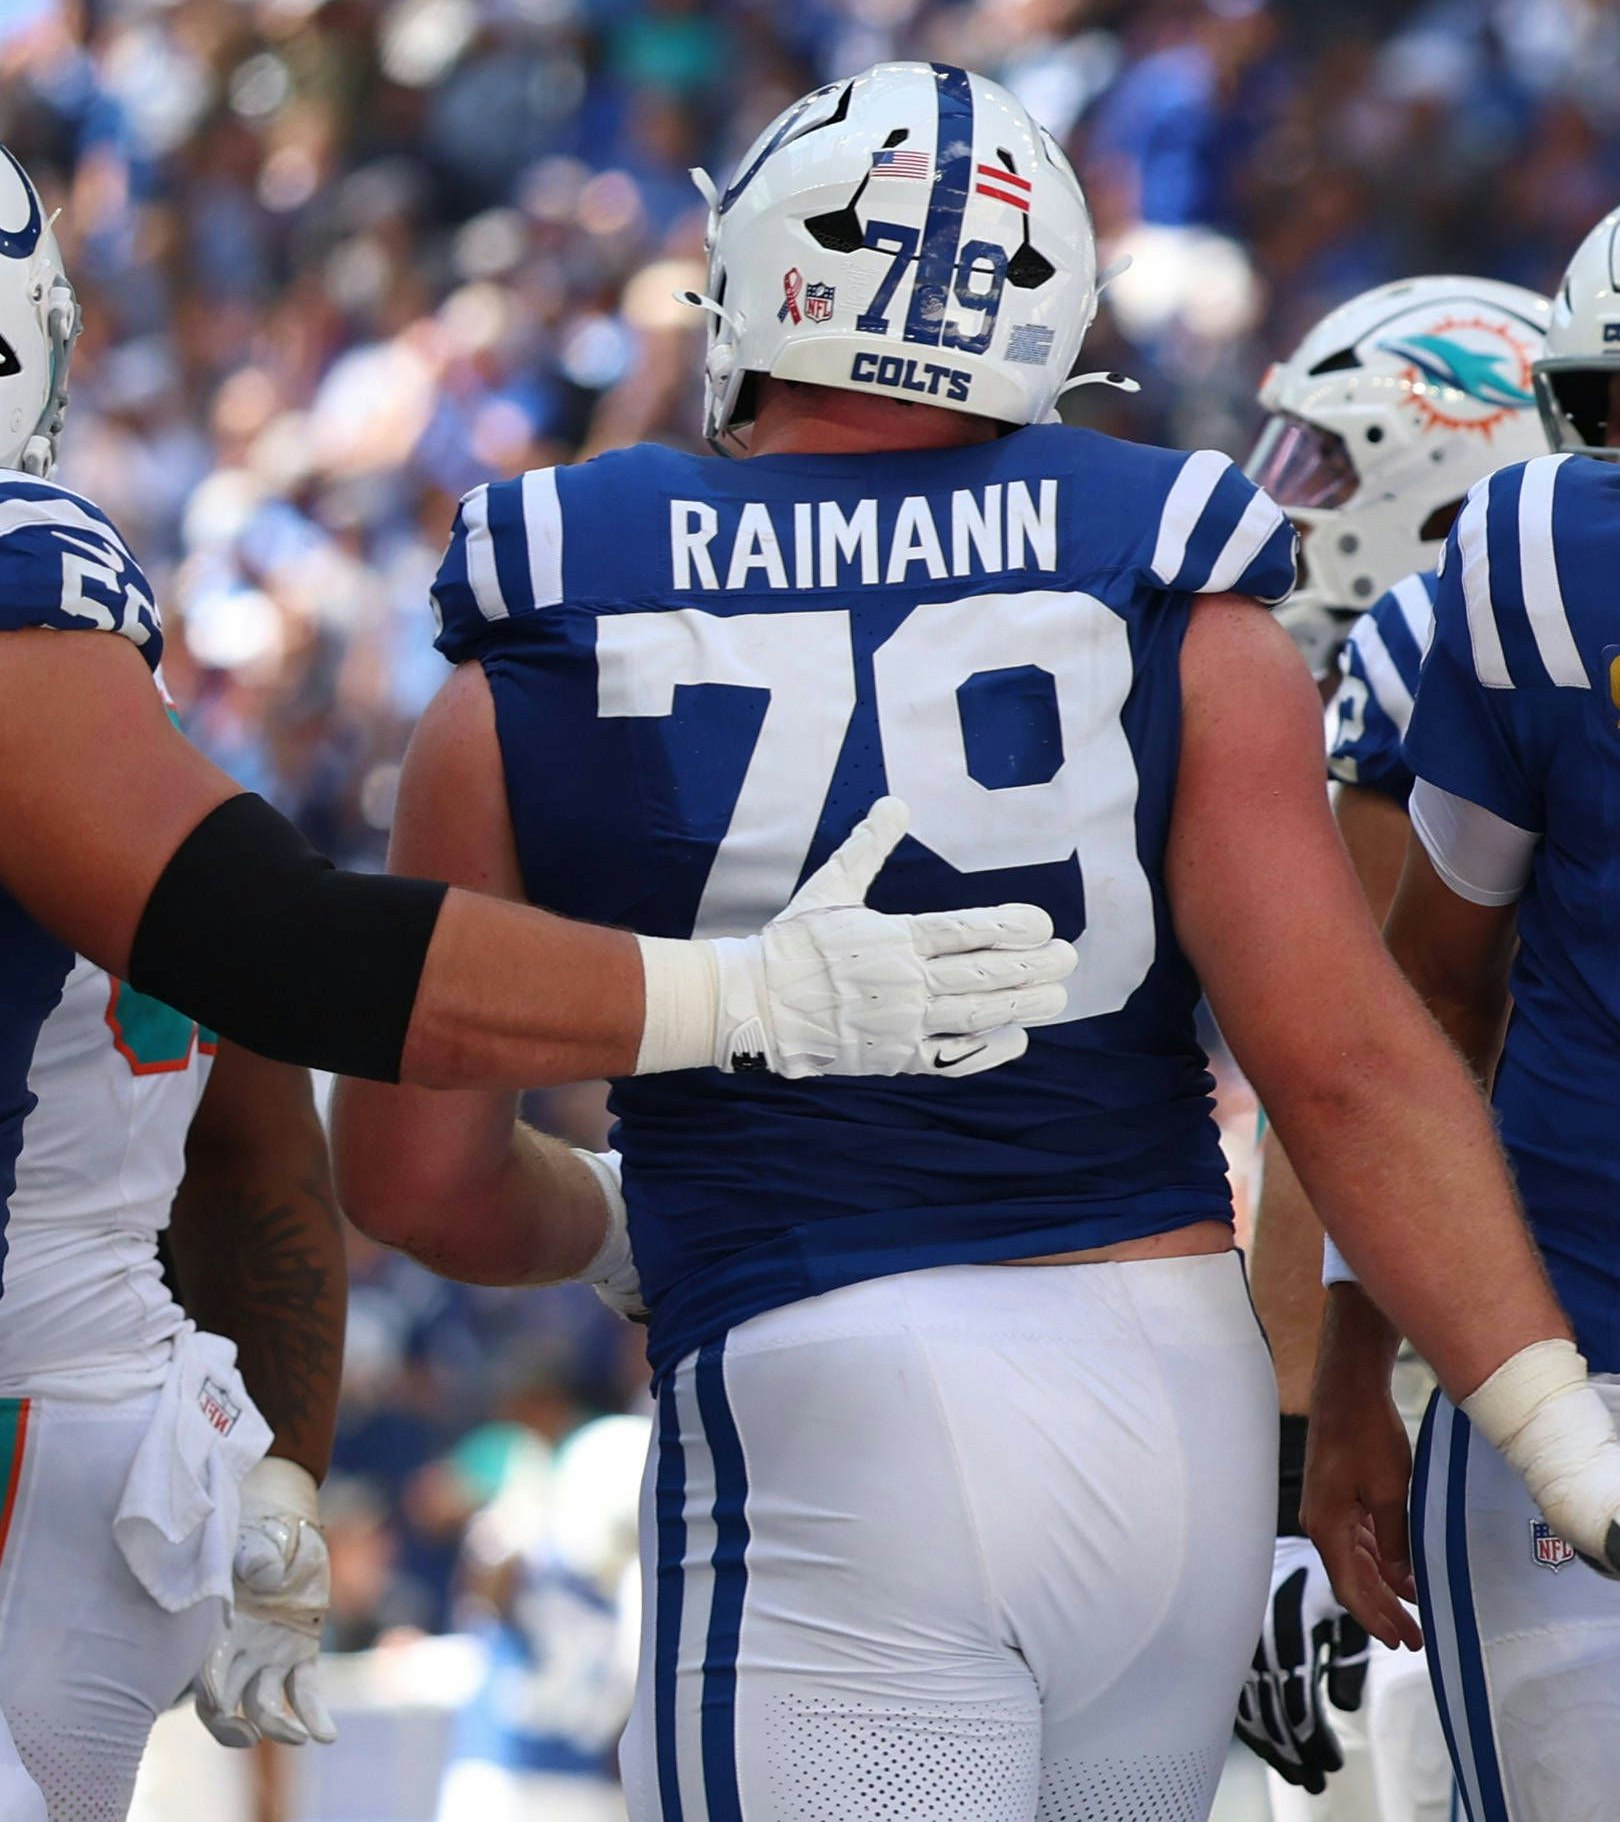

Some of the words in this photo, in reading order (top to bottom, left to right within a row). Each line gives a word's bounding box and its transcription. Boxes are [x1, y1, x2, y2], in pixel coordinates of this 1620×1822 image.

[807, 298, 833, 319] NFL
[856, 220, 1008, 355] 79
[851, 352, 973, 402] COLTS
[669, 479, 1059, 591] RAIMANN
[596, 590, 1157, 1028] 79
[1538, 1539, 1572, 1562] NFL
